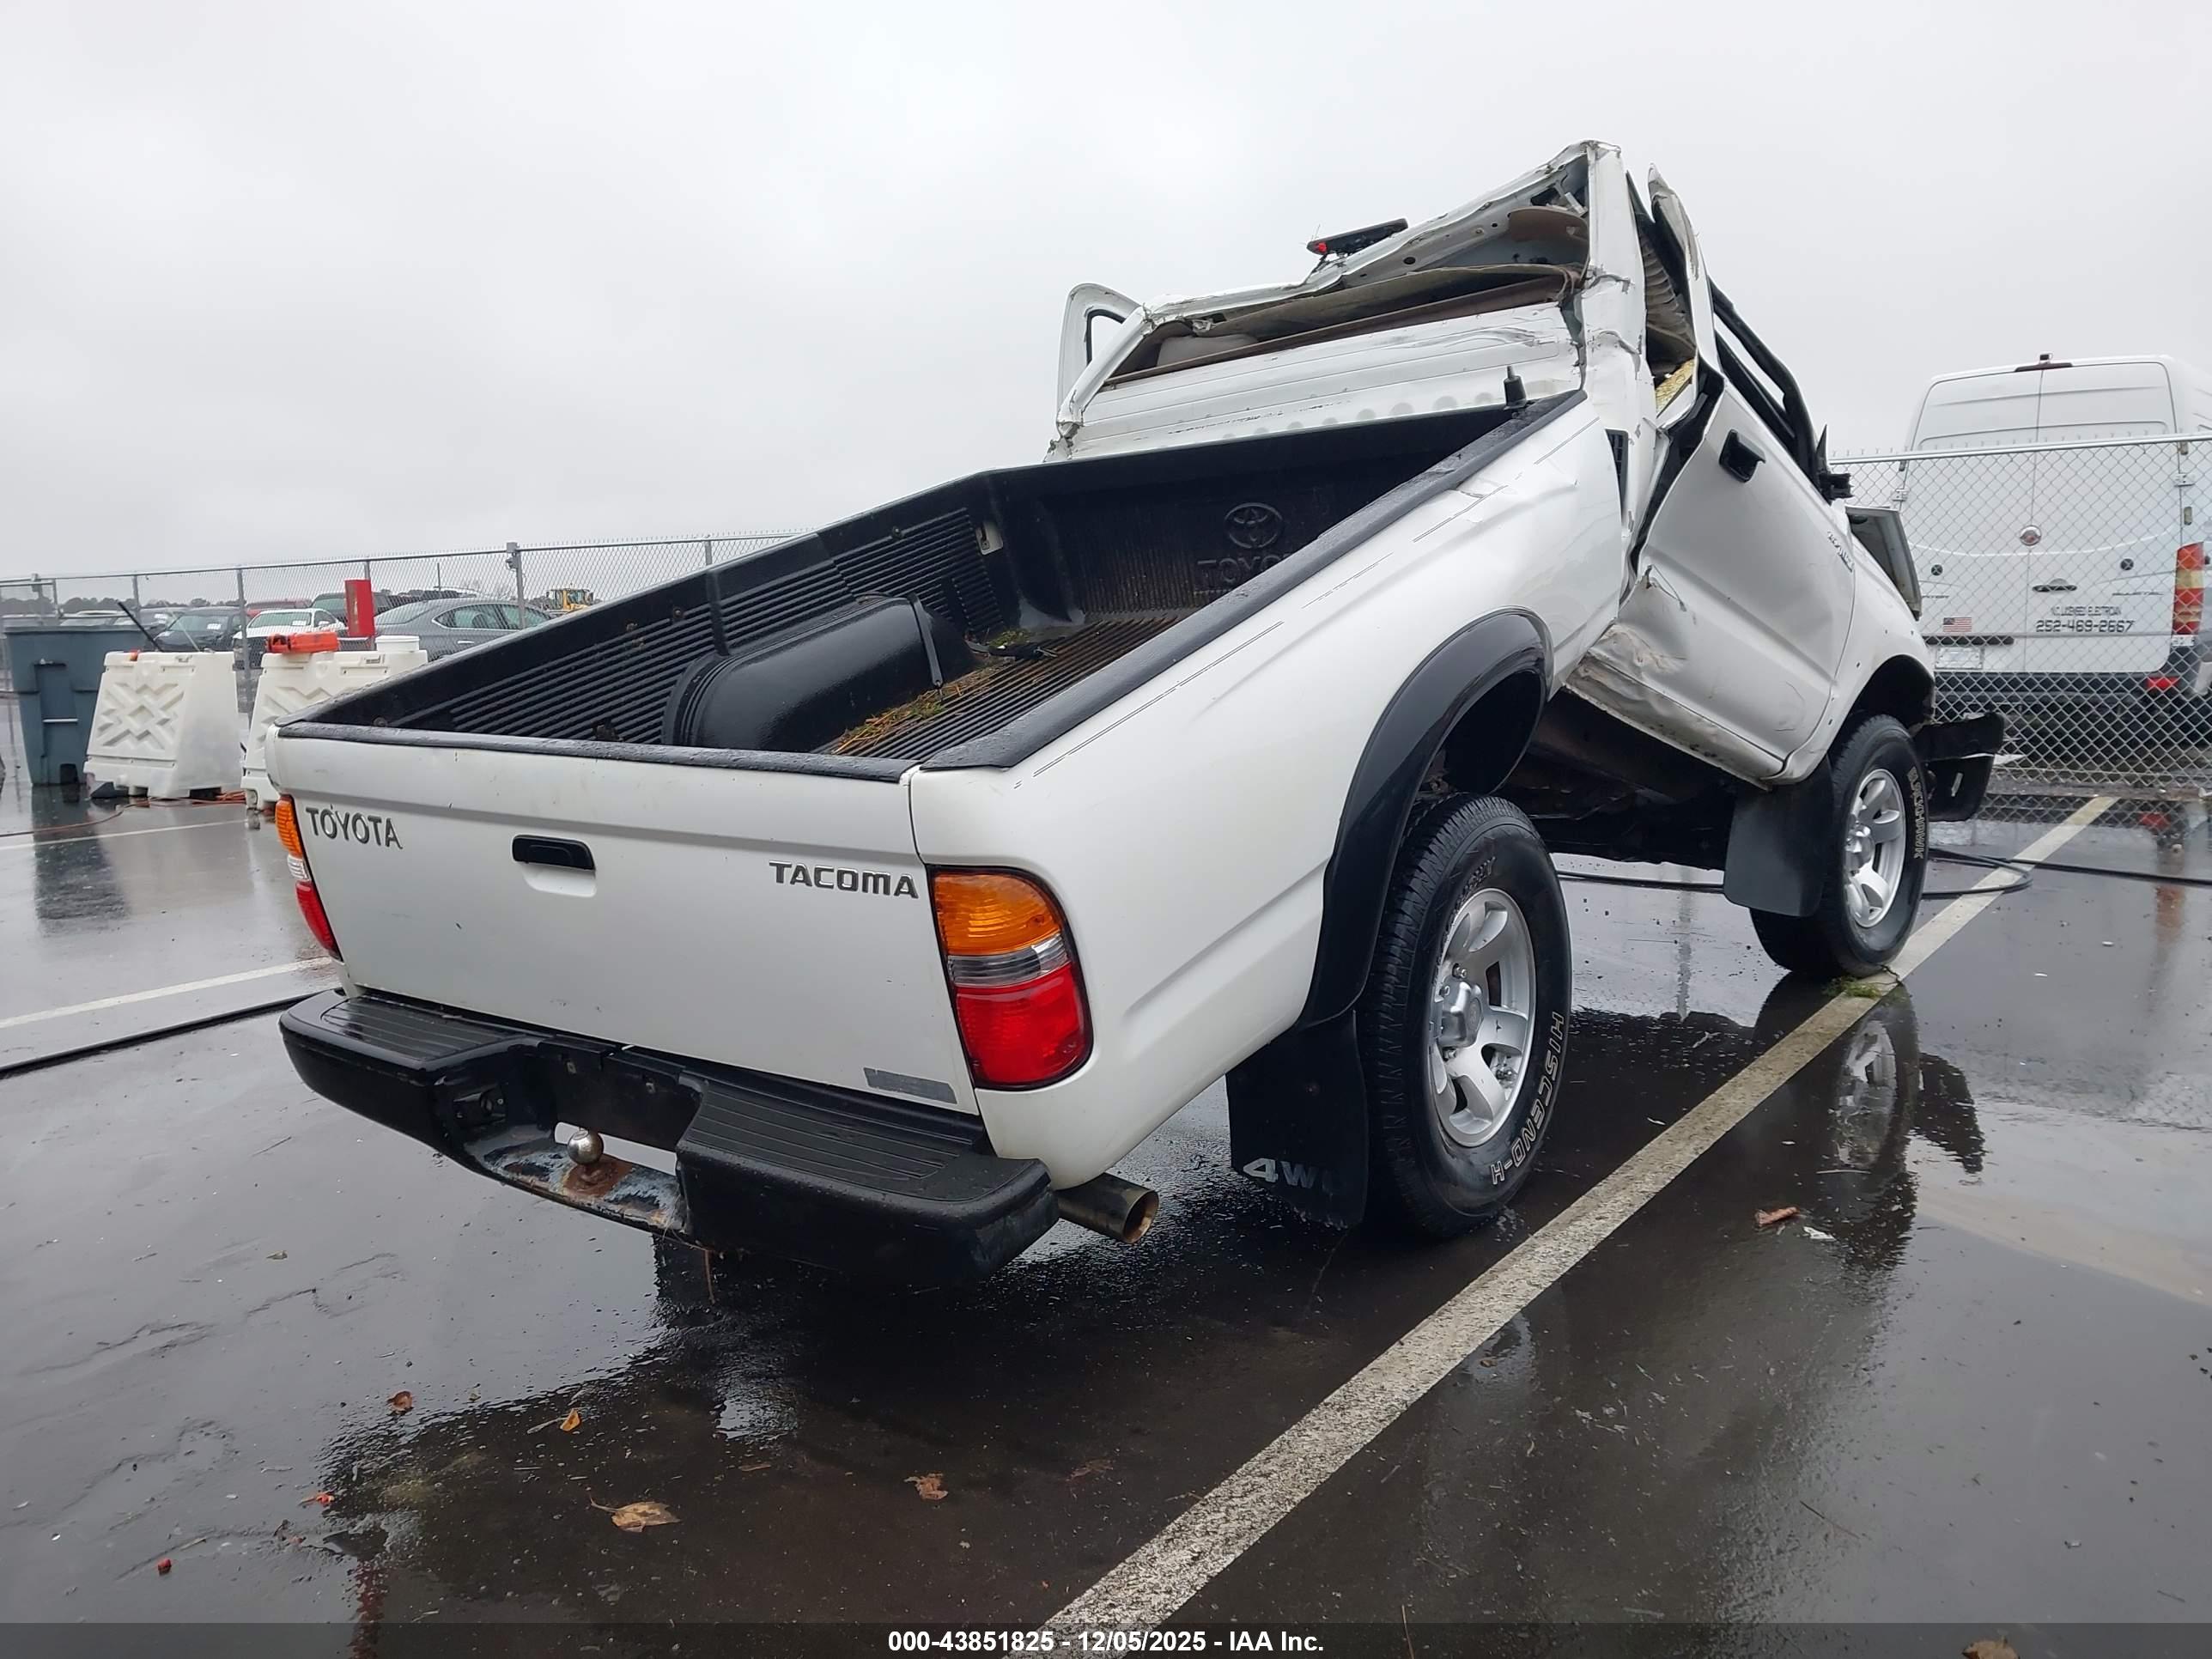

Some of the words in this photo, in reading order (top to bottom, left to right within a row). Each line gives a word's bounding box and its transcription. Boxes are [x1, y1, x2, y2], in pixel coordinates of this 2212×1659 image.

[2035, 619, 2136, 633] 252-469-2667
[305, 806, 404, 850] TOYOTA
[769, 860, 920, 900] TACOMA
[1489, 1011, 1565, 1185] HISCEND-H
[1243, 1158, 1340, 1194] 4W
